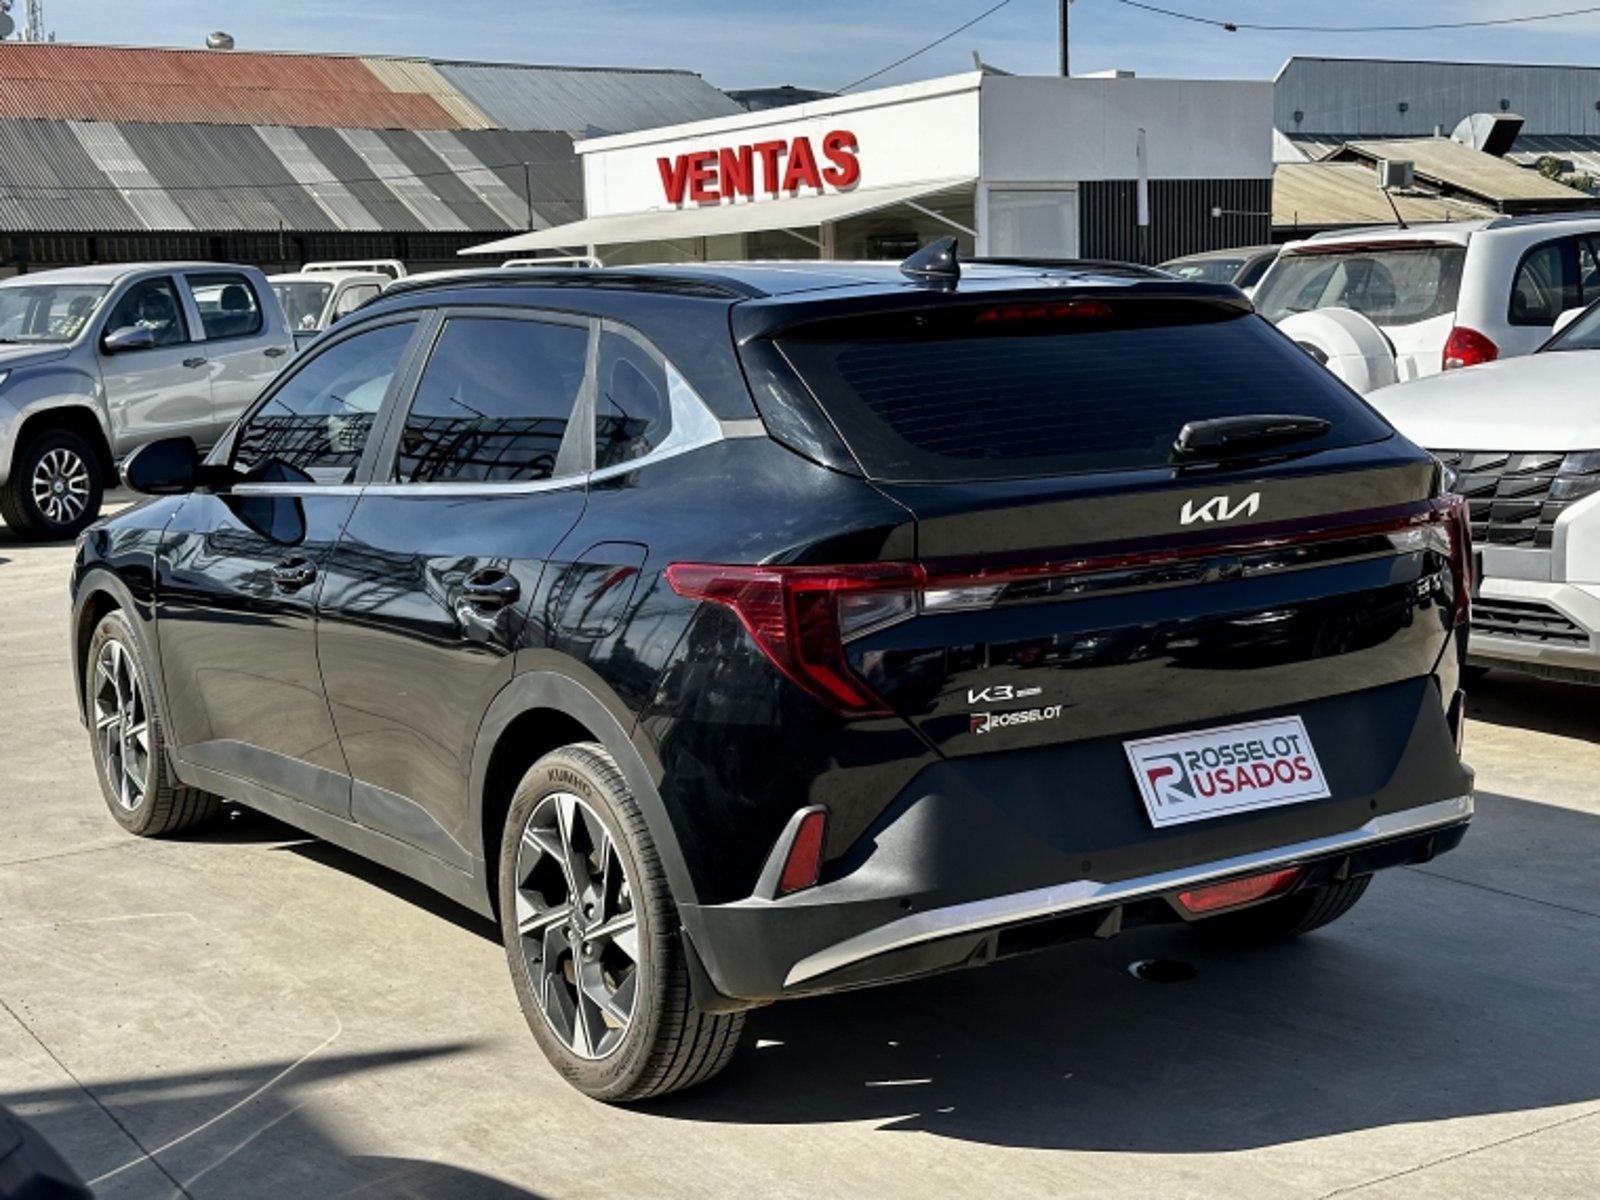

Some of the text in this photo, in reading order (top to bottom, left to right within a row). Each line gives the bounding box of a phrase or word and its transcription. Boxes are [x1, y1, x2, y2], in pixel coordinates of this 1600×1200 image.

[657, 130, 860, 204] VENTAS
[1180, 492, 1260, 525] KIA
[967, 685, 1014, 704] K3
[991, 705, 1062, 728] ROSSELOT
[1185, 735, 1300, 771] ROSSELOT
[547, 768, 593, 798] KUMHO
[1193, 756, 1313, 797] USADOS
